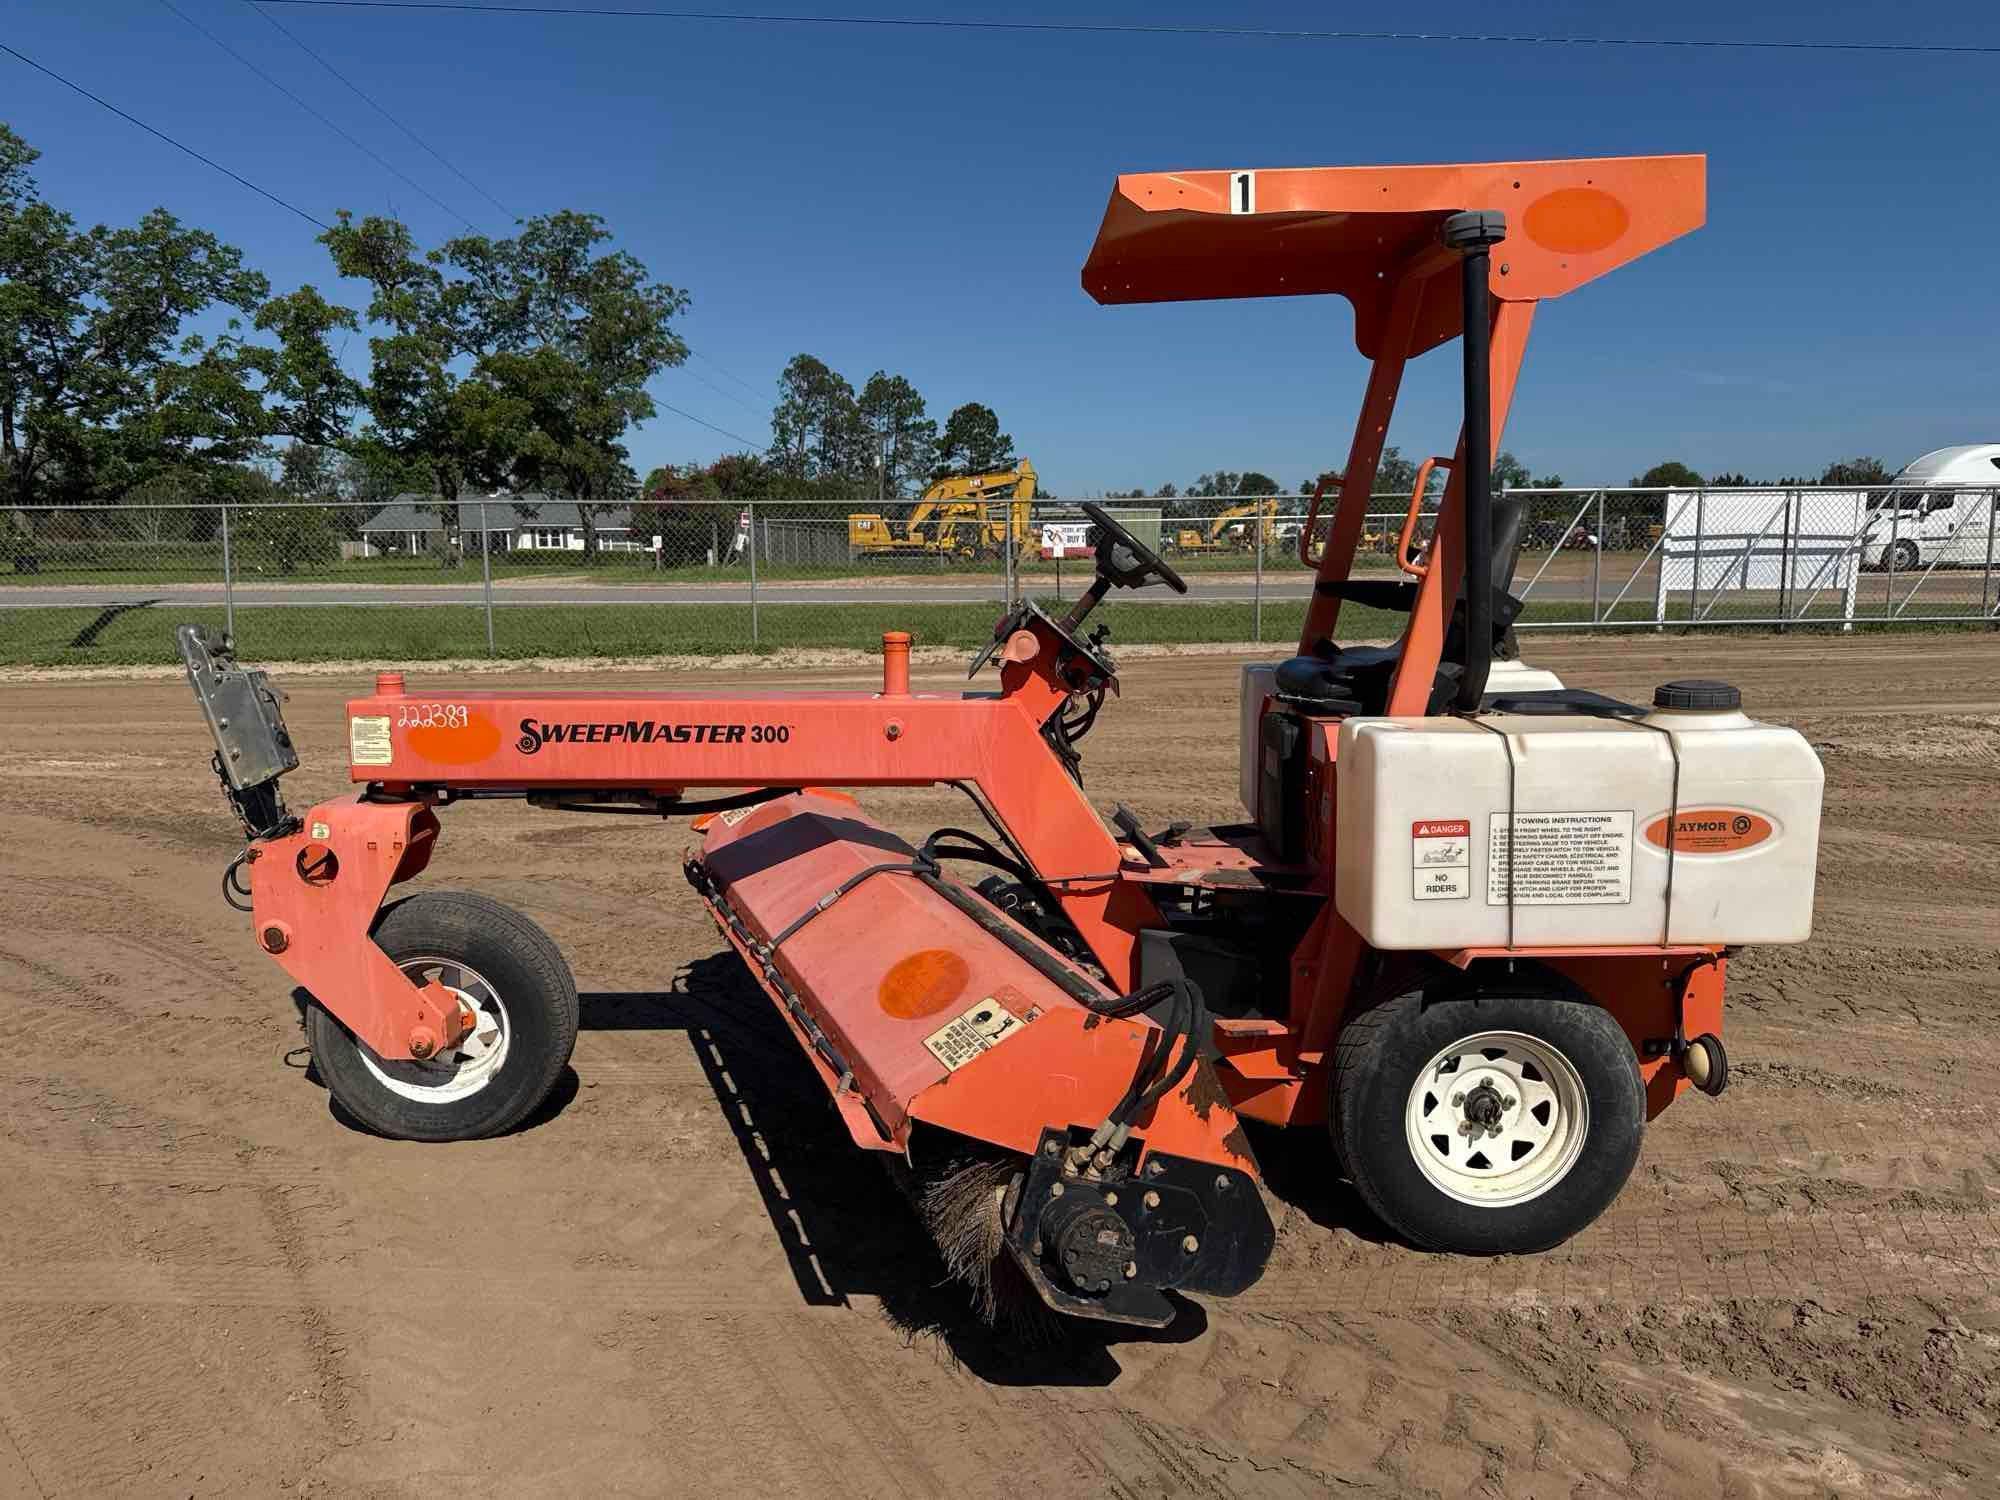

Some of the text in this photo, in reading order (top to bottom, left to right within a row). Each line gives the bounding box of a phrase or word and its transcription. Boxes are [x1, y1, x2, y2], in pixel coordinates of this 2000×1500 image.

[1237, 174, 1250, 213] 1
[398, 703, 468, 729] 222389
[750, 725, 790, 743] 300
[1551, 816, 1613, 824] INSTRUCTIONS
[1430, 824, 1465, 833] DANGER
[1434, 873, 1448, 882] NO
[1425, 884, 1457, 893] RIDERS
